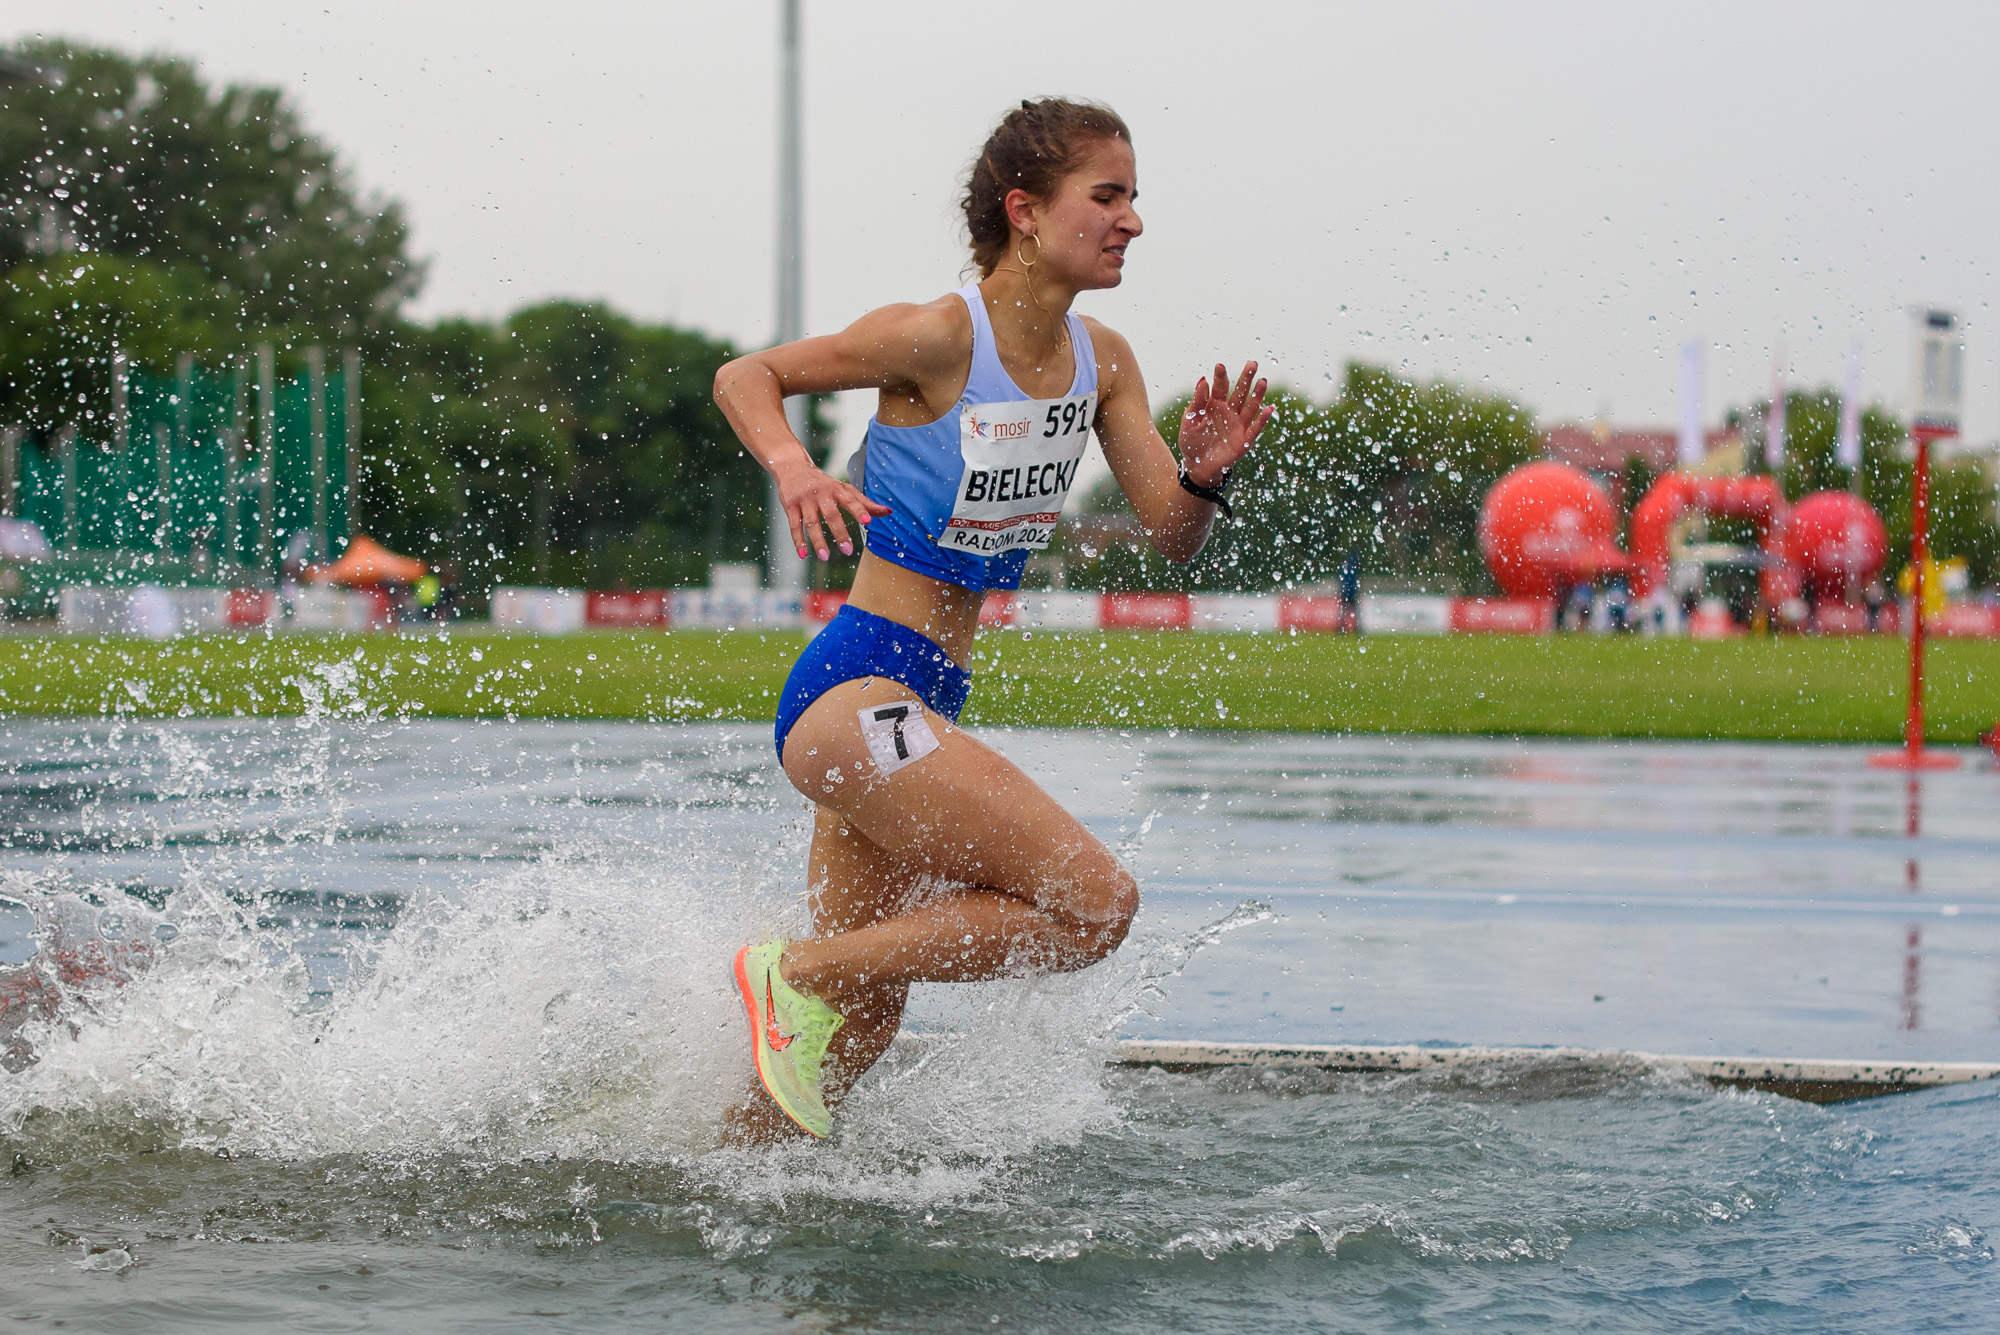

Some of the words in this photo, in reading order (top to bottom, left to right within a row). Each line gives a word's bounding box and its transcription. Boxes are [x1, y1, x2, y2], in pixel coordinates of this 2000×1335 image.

[994, 416, 1032, 438] mosir
[1043, 399, 1088, 438] 591
[954, 531, 1017, 550] RADOM
[873, 706, 910, 760] 7
